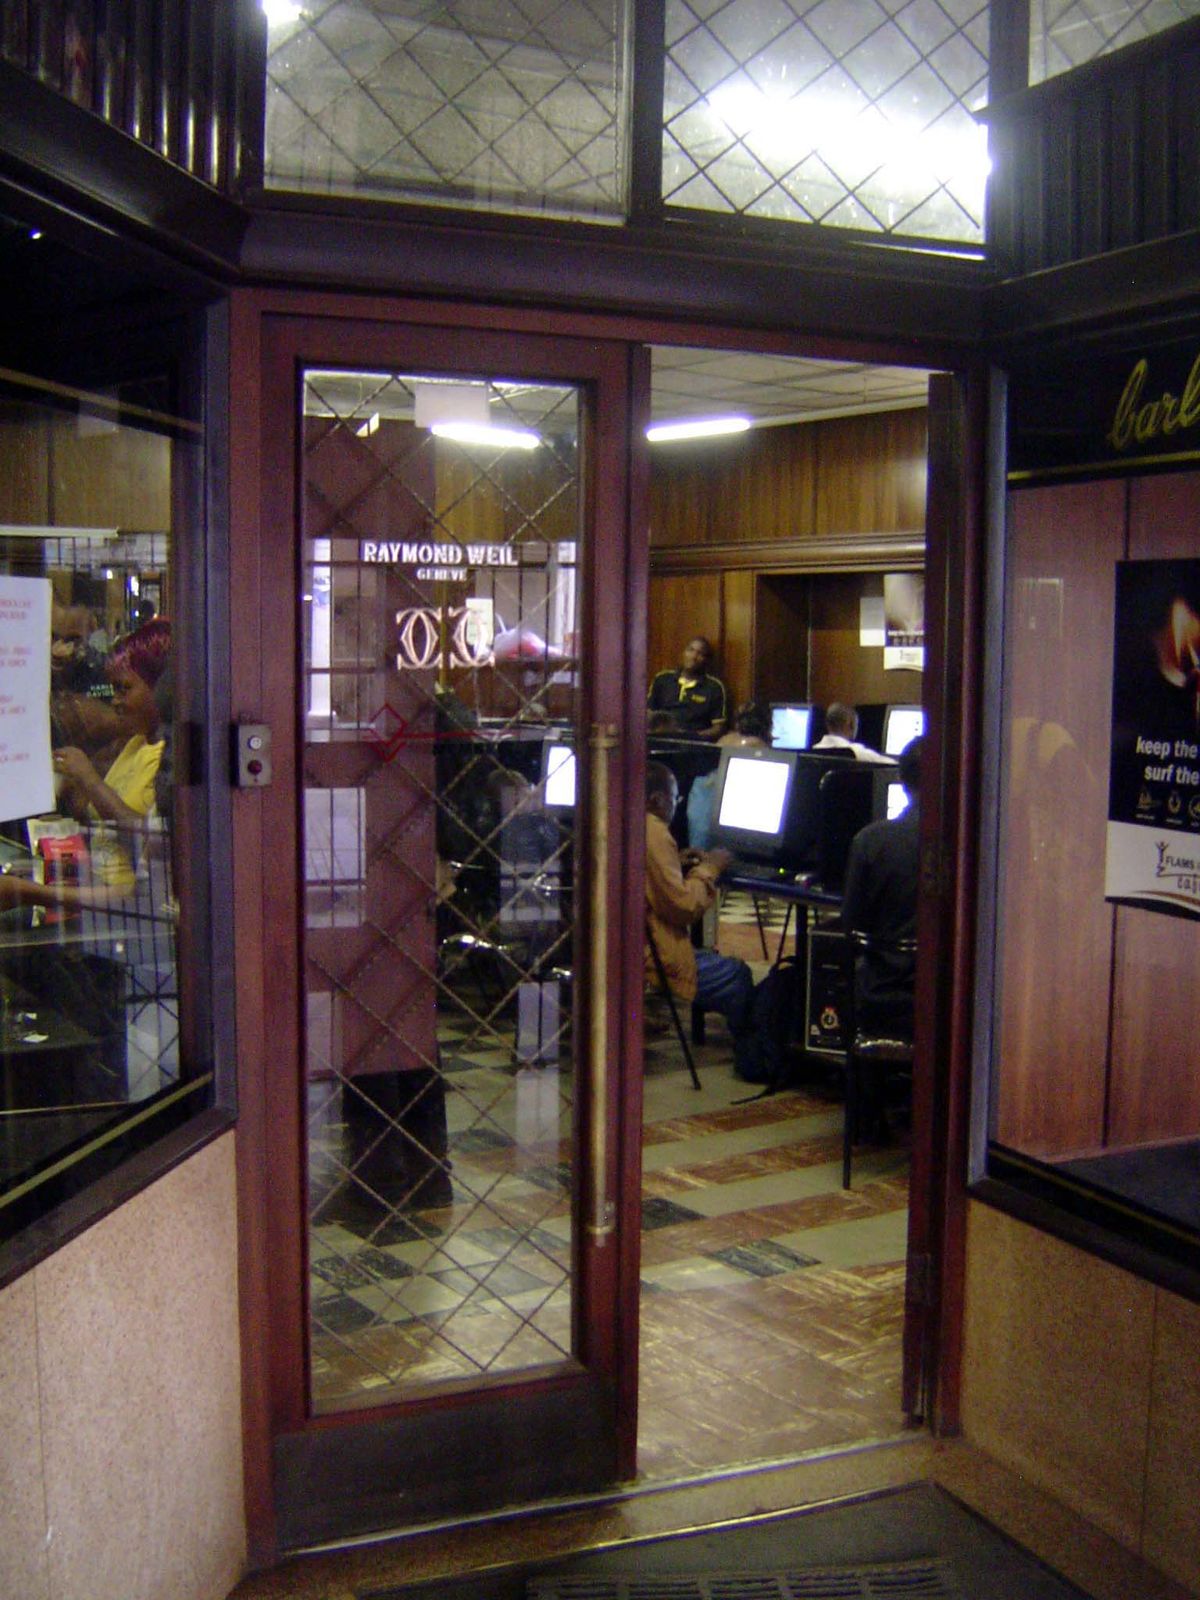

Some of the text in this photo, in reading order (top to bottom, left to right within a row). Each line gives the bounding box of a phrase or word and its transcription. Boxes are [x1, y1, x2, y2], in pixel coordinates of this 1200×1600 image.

[363, 542, 518, 566] RAYMOND WEIL
[1136, 736, 1198, 760] keep the
[1144, 763, 1200, 785] surf the
